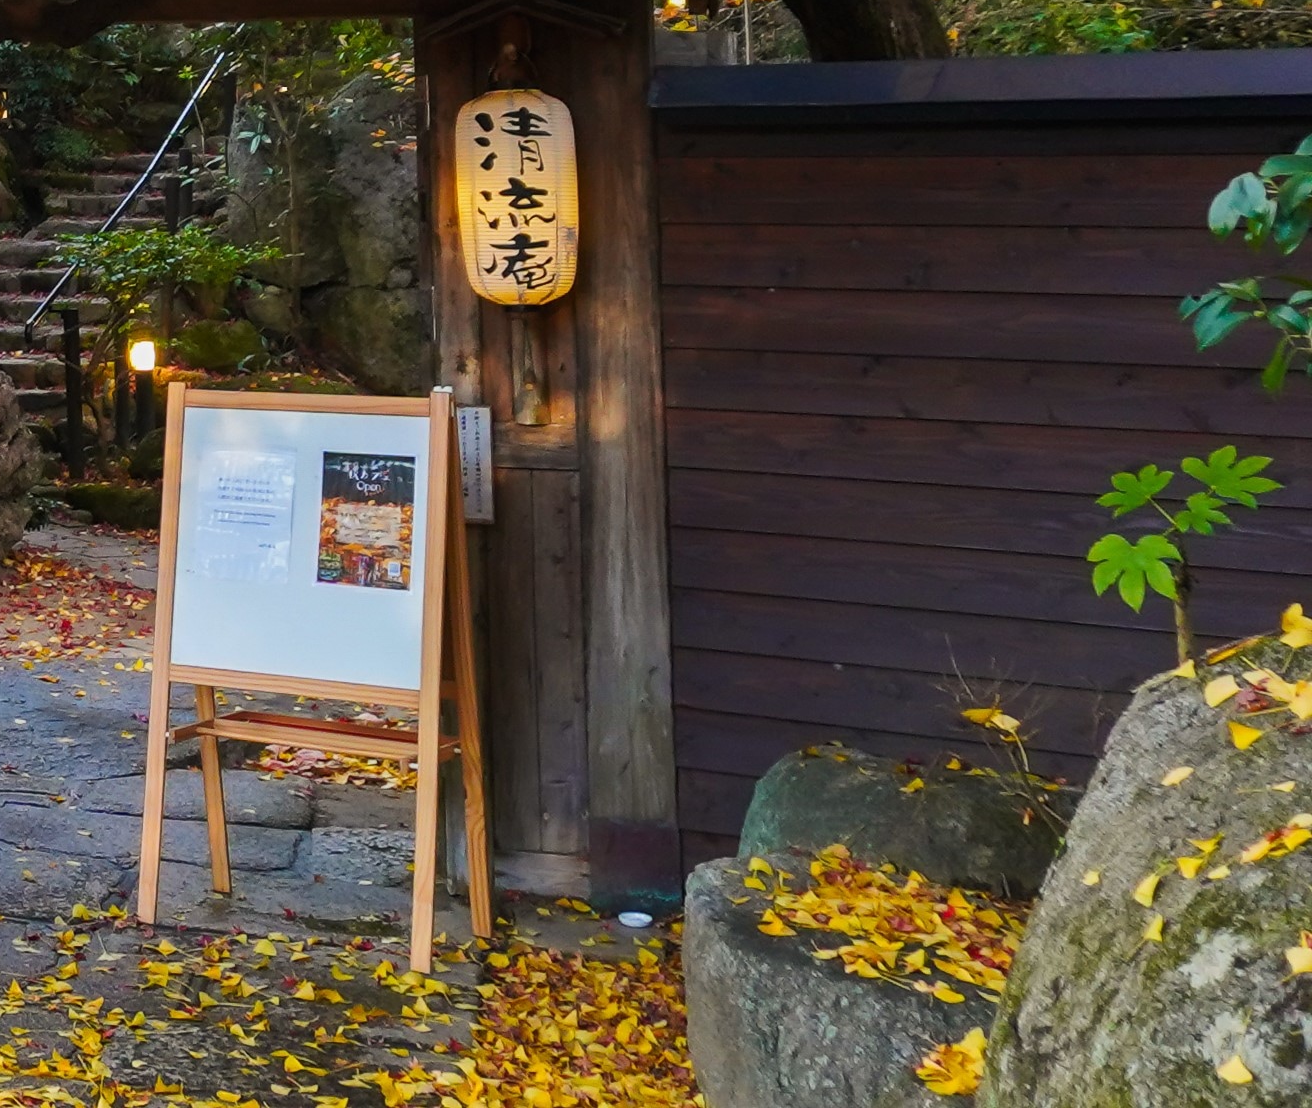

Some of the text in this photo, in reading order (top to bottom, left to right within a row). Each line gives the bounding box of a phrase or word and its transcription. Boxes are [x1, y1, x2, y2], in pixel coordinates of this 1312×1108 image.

[474, 106, 555, 290] 清流庵
[356, 480, 382, 494] Open
